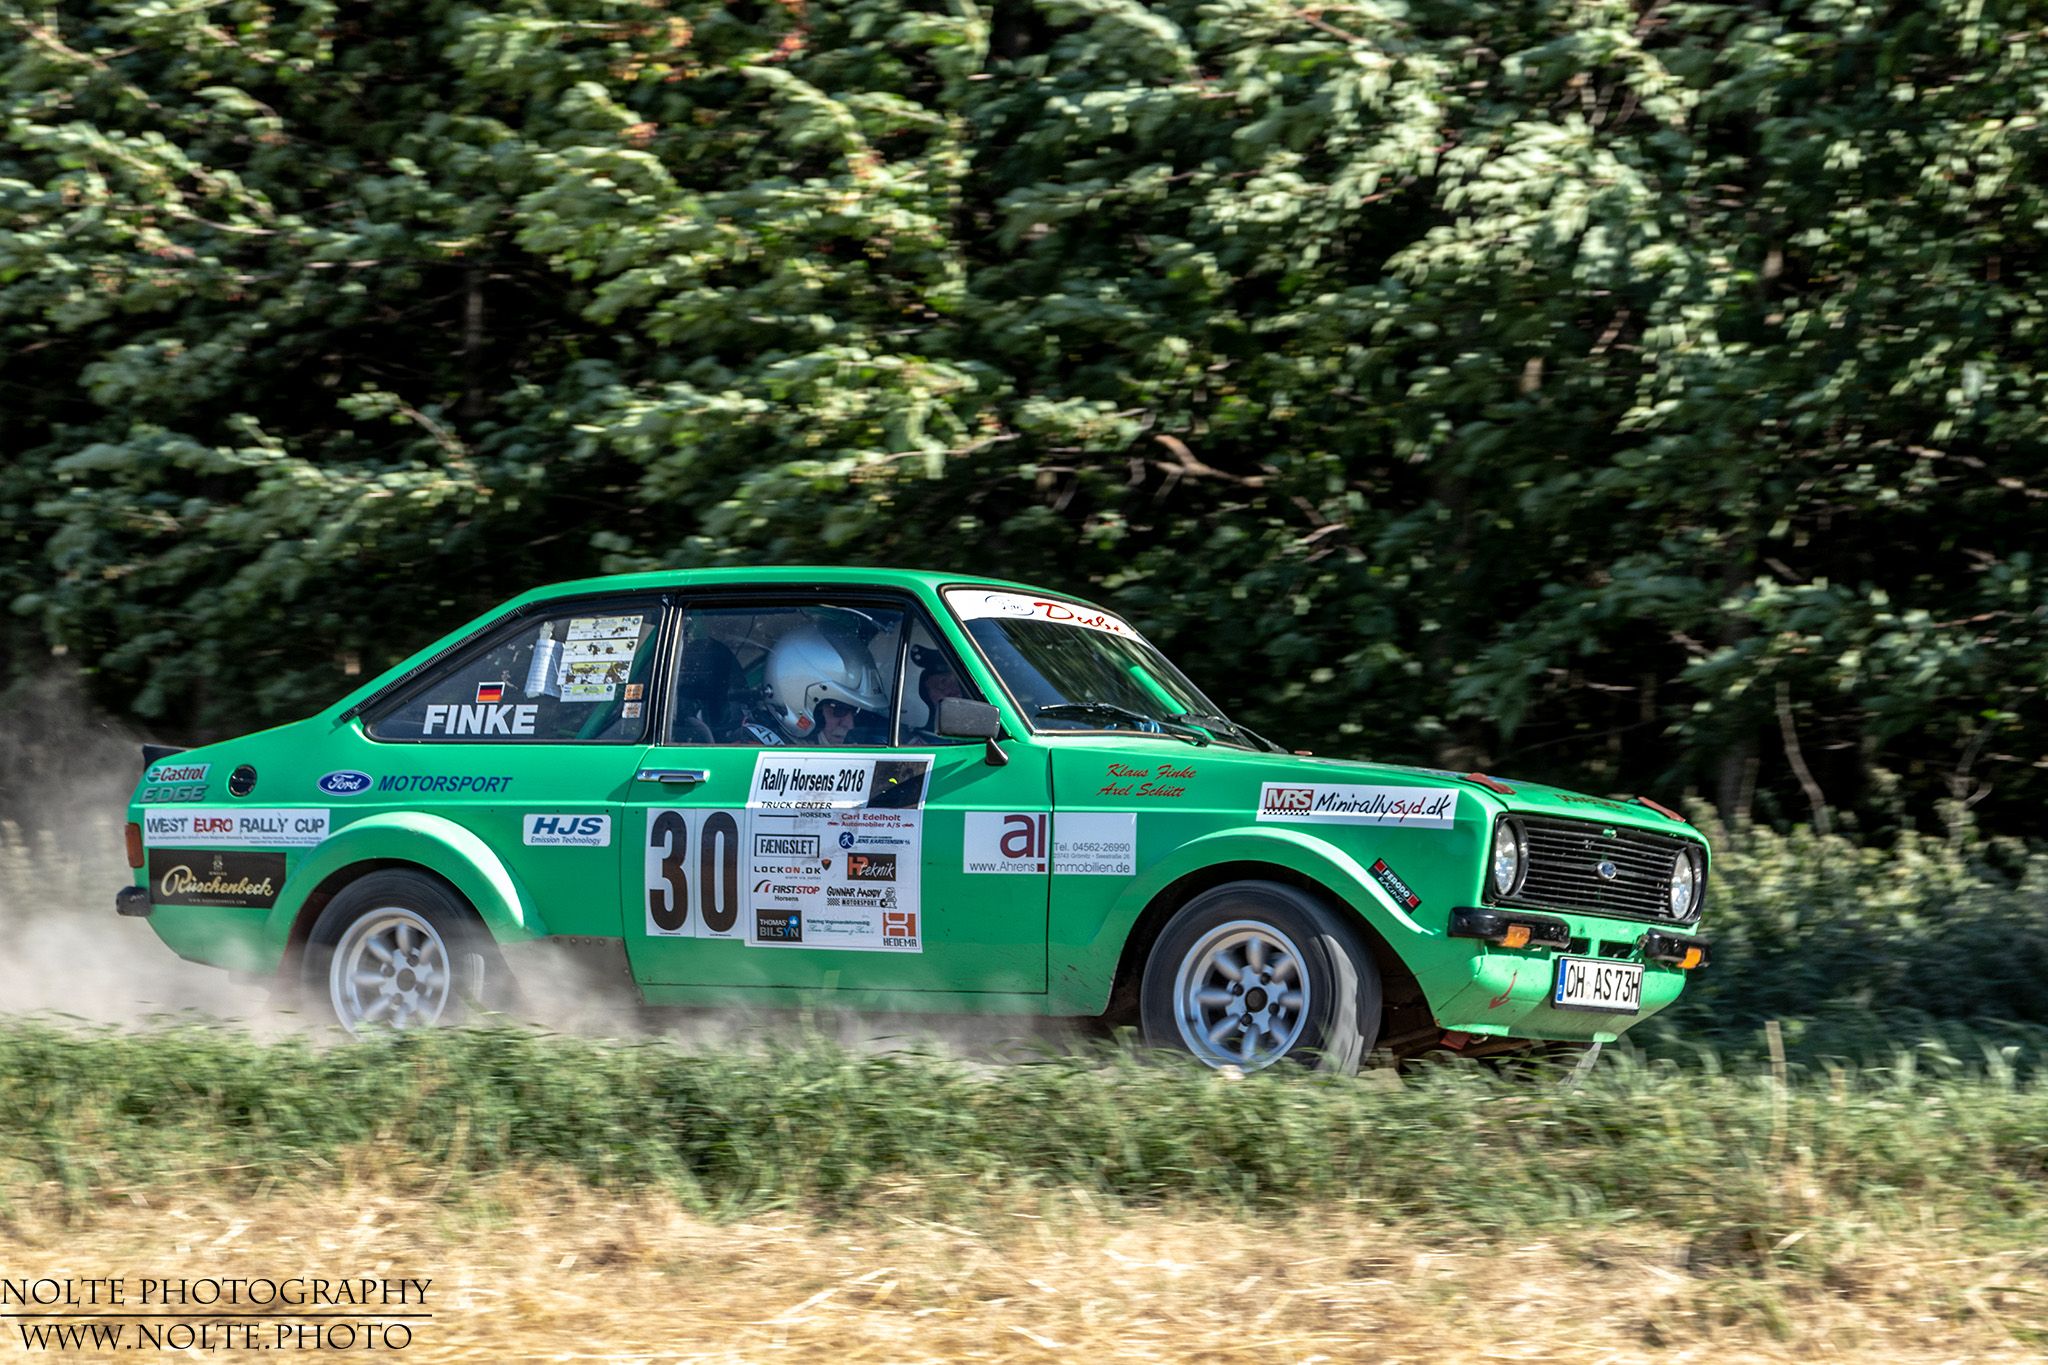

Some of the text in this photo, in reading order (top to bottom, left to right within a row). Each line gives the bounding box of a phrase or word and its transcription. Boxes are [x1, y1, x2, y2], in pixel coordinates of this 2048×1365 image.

[422, 704, 538, 735] FINKE
[160, 765, 206, 782] Castrol
[1106, 763, 1197, 780] Klaus Finke
[327, 774, 362, 791] Ford
[378, 775, 513, 792] MOTORSPORT
[760, 768, 865, 797] Rally Horsens 2018
[1096, 782, 1186, 797] Axel Schütt
[139, 784, 210, 804] EDGE
[761, 801, 832, 810] TRUCK CENTER
[1265, 789, 1450, 822] MRS Minirallysyd.dk
[146, 816, 325, 833] WEST EURO RALLY CUP
[863, 813, 901, 821] Edelholt
[532, 817, 603, 835] HJS
[531, 836, 601, 846] Emission Technology
[760, 839, 814, 854] FÆNGSLET
[1054, 842, 1131, 852] Tel. 04562-26990
[649, 810, 739, 933] 30
[754, 865, 821, 875] LOCKON.DK
[859, 862, 895, 878] teknik
[161, 864, 274, 897] Rüschenbeck
[1383, 869, 1410, 898] FERODO
[772, 884, 820, 895] FIRSTSTOP
[826, 885, 856, 898] GUNNAR
[1378, 876, 1404, 904] RACING
[842, 898, 878, 907] MOTORSPORT
[760, 926, 800, 937] BILSYN
[883, 938, 917, 948] HEDEMA
[1566, 964, 1586, 998] OH
